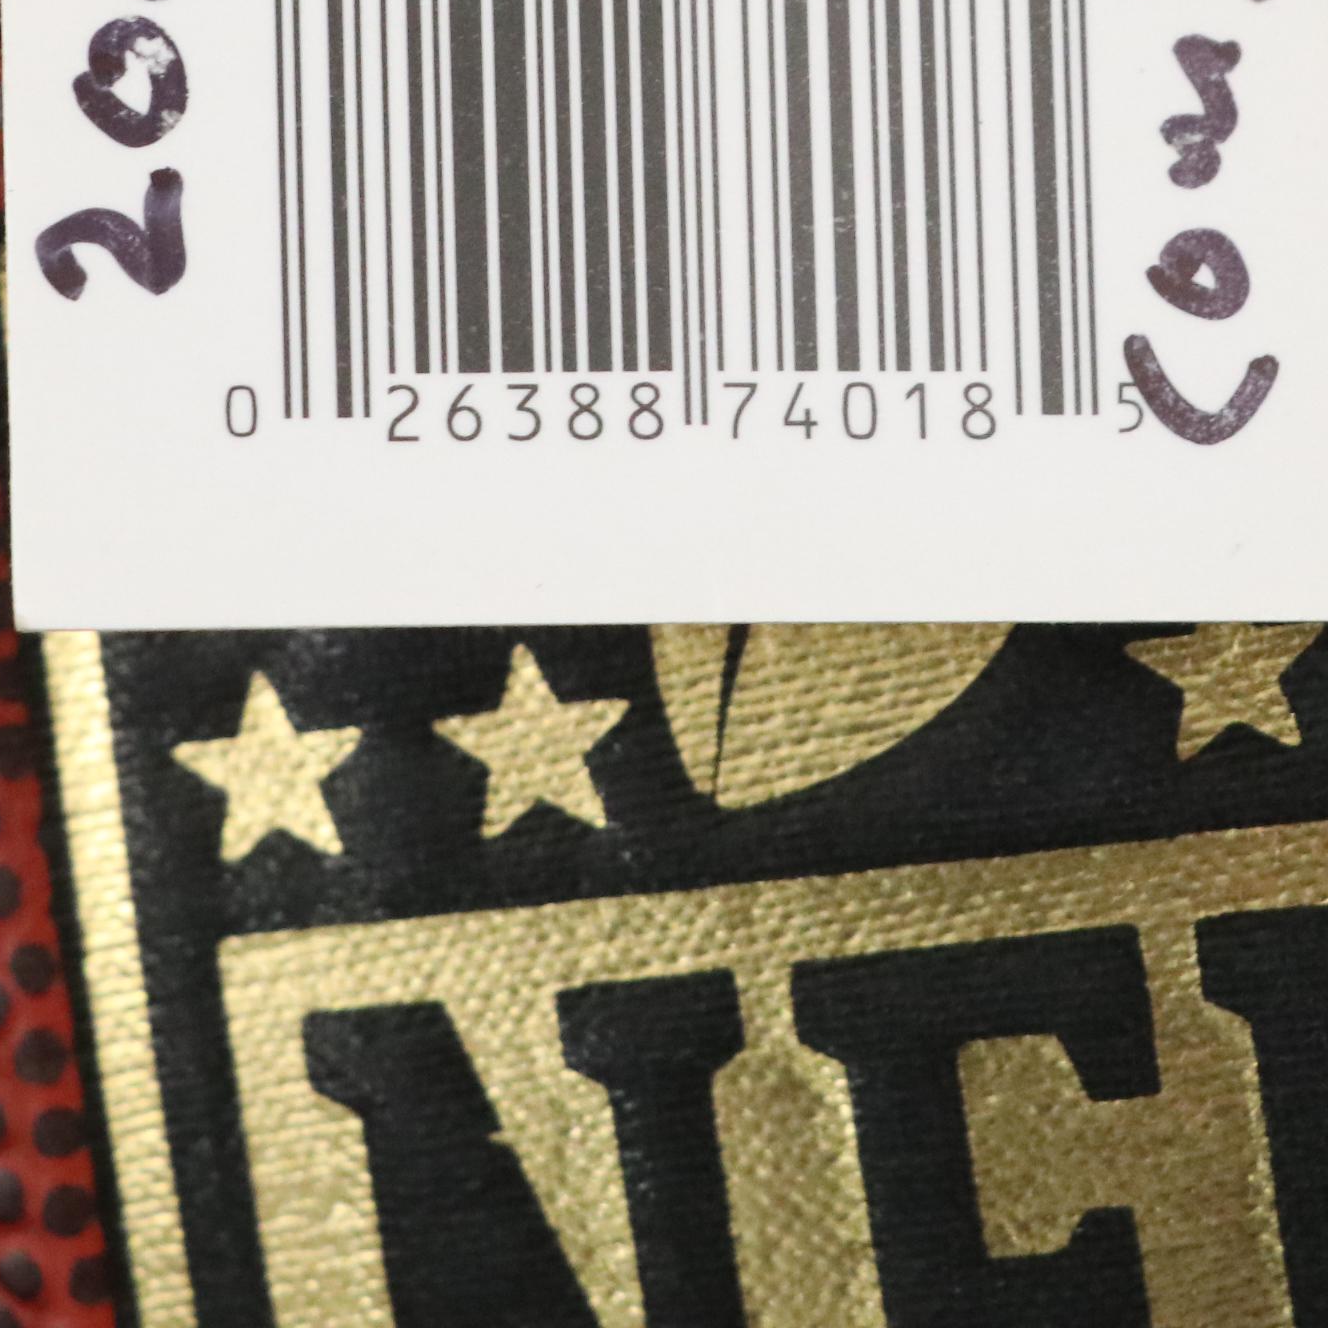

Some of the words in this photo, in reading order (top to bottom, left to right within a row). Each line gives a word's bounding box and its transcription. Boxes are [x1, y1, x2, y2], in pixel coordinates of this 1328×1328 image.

[225, 384, 259, 439] 0
[386, 382, 666, 443] 26388
[722, 381, 997, 441] 74018
